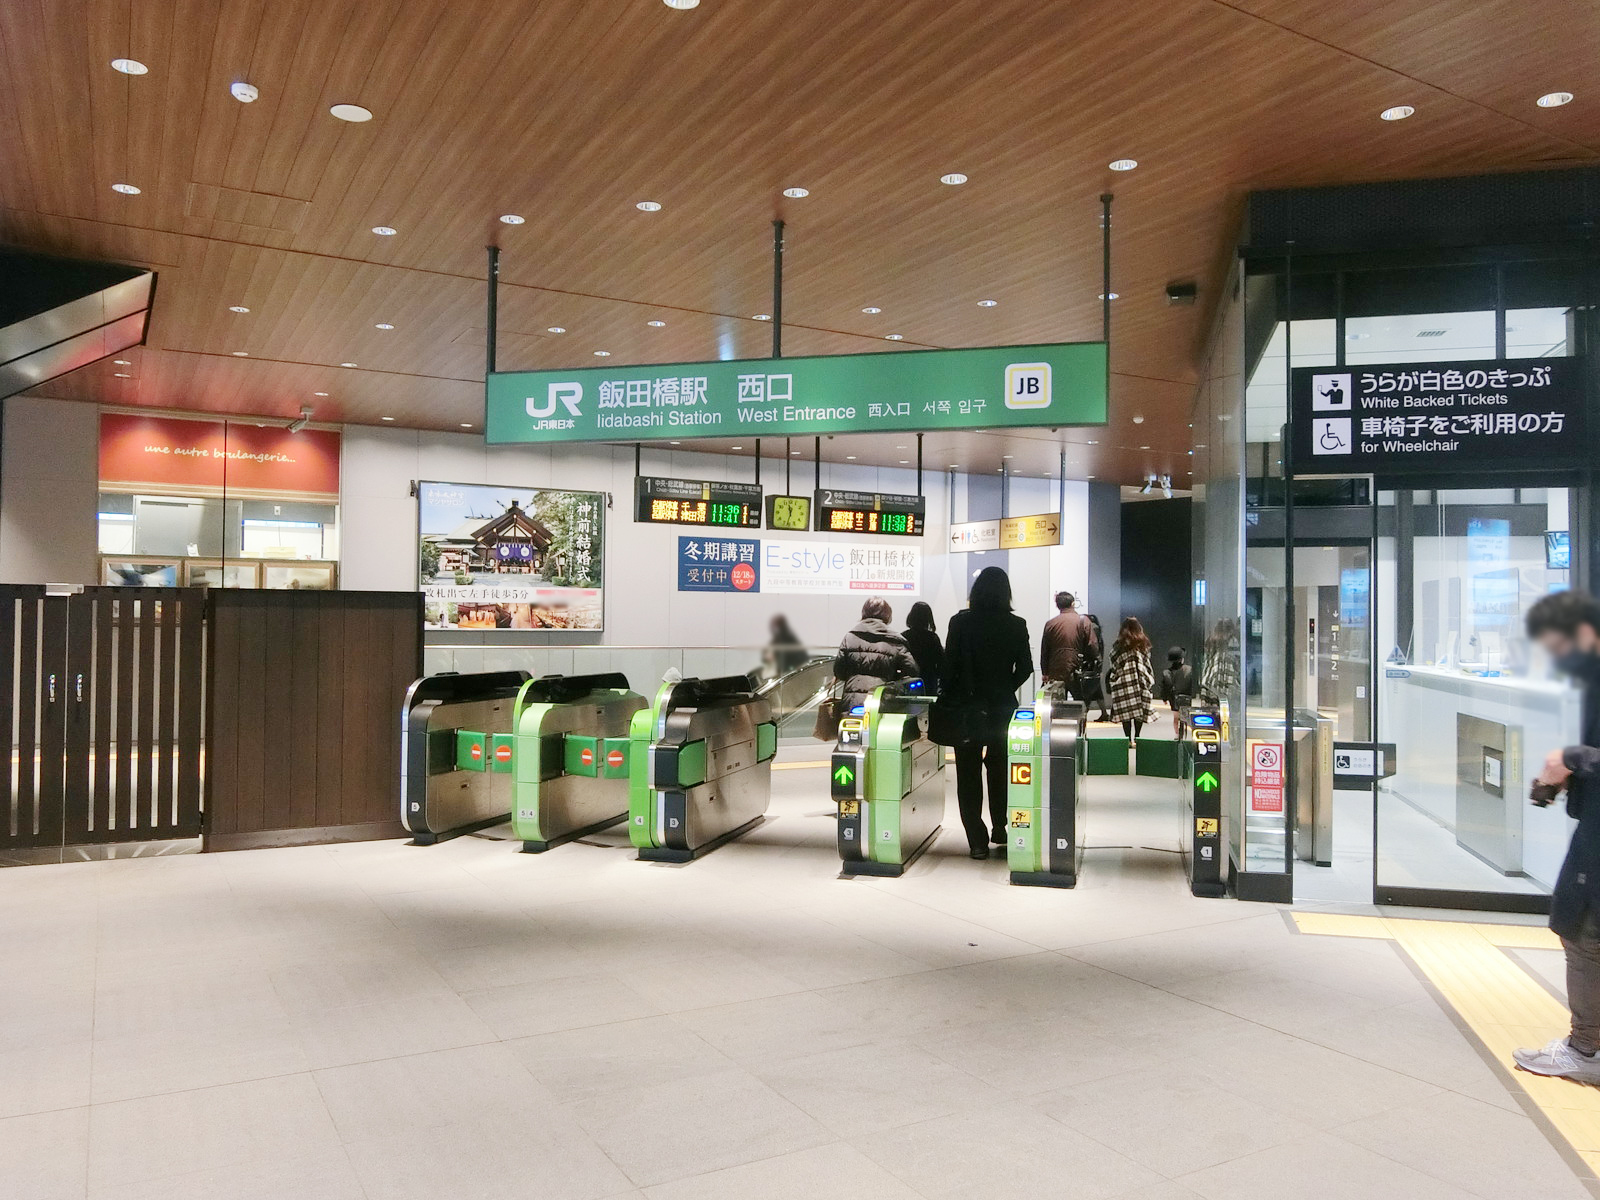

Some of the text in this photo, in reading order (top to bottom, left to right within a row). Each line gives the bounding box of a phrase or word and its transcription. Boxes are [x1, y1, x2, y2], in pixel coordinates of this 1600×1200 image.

[737, 373, 793, 404] 西口
[1016, 377, 1040, 396] JB
[1360, 366, 1552, 394] うらが白色のきっぷ
[525, 381, 584, 418] JR
[597, 376, 708, 409] 飯田橋駅
[1361, 392, 1508, 409] White Backed Tickets
[737, 405, 856, 423] West Entrance
[868, 402, 911, 418] 西入口
[922, 399, 988, 416] 서쪽 입구
[532, 419, 576, 431] JR東日本
[597, 409, 722, 429] Iidabashi Station
[1360, 411, 1566, 438] 車椅子をご利用の方
[144, 445, 170, 454] une
[174, 446, 209, 457] autre
[1361, 438, 1460, 453] for Wheelchair
[645, 478, 651, 493] 1
[824, 490, 833, 505] 2
[712, 503, 740, 514] 11:36
[712, 513, 739, 524] 11:41
[1034, 520, 1047, 529] 西口
[576, 501, 592, 582] 神前結婚式
[684, 540, 755, 563] 冬期講習
[766, 545, 845, 573] E-style
[850, 548, 915, 568] 飯田橋校
[687, 568, 727, 583] 受付中
[425, 588, 529, 600] 改札出て左手徒歩5分
[1331, 661, 1337, 671] 2
[1012, 765, 1031, 783] IC
